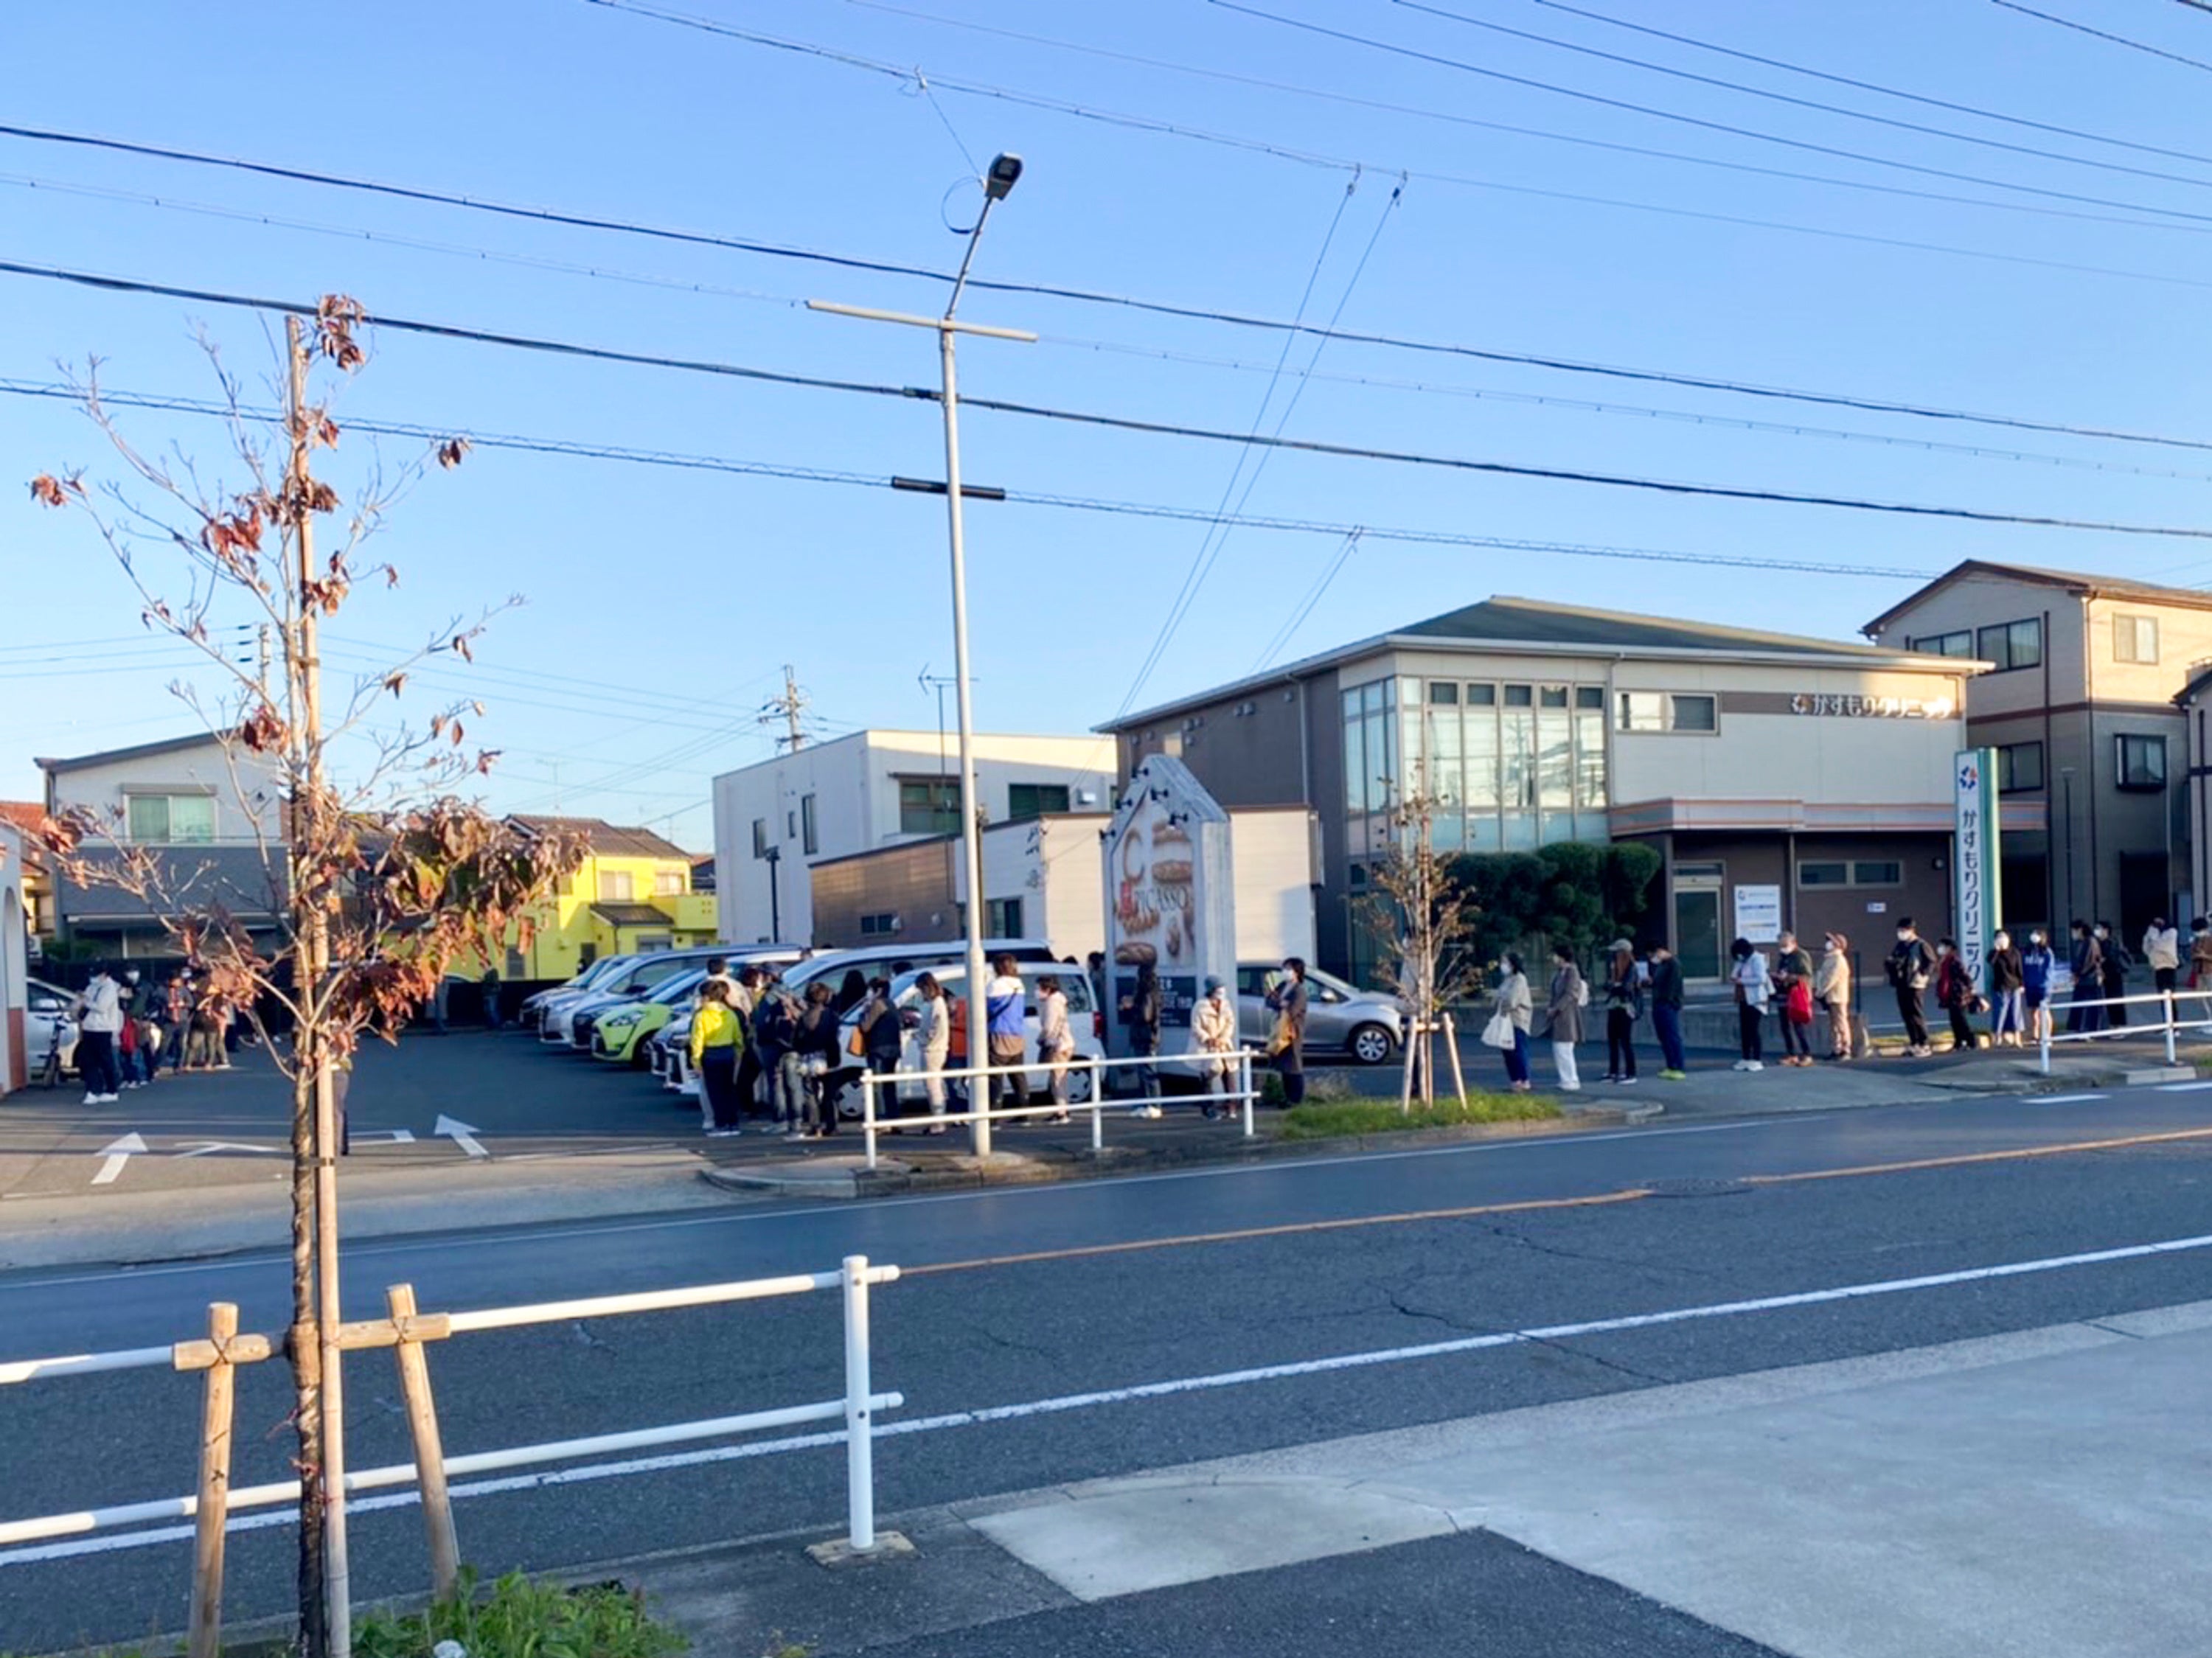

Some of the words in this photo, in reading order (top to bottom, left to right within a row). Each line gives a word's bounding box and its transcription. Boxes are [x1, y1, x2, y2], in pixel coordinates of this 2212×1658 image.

[1963, 809, 1980, 982] かすもりクリニック
